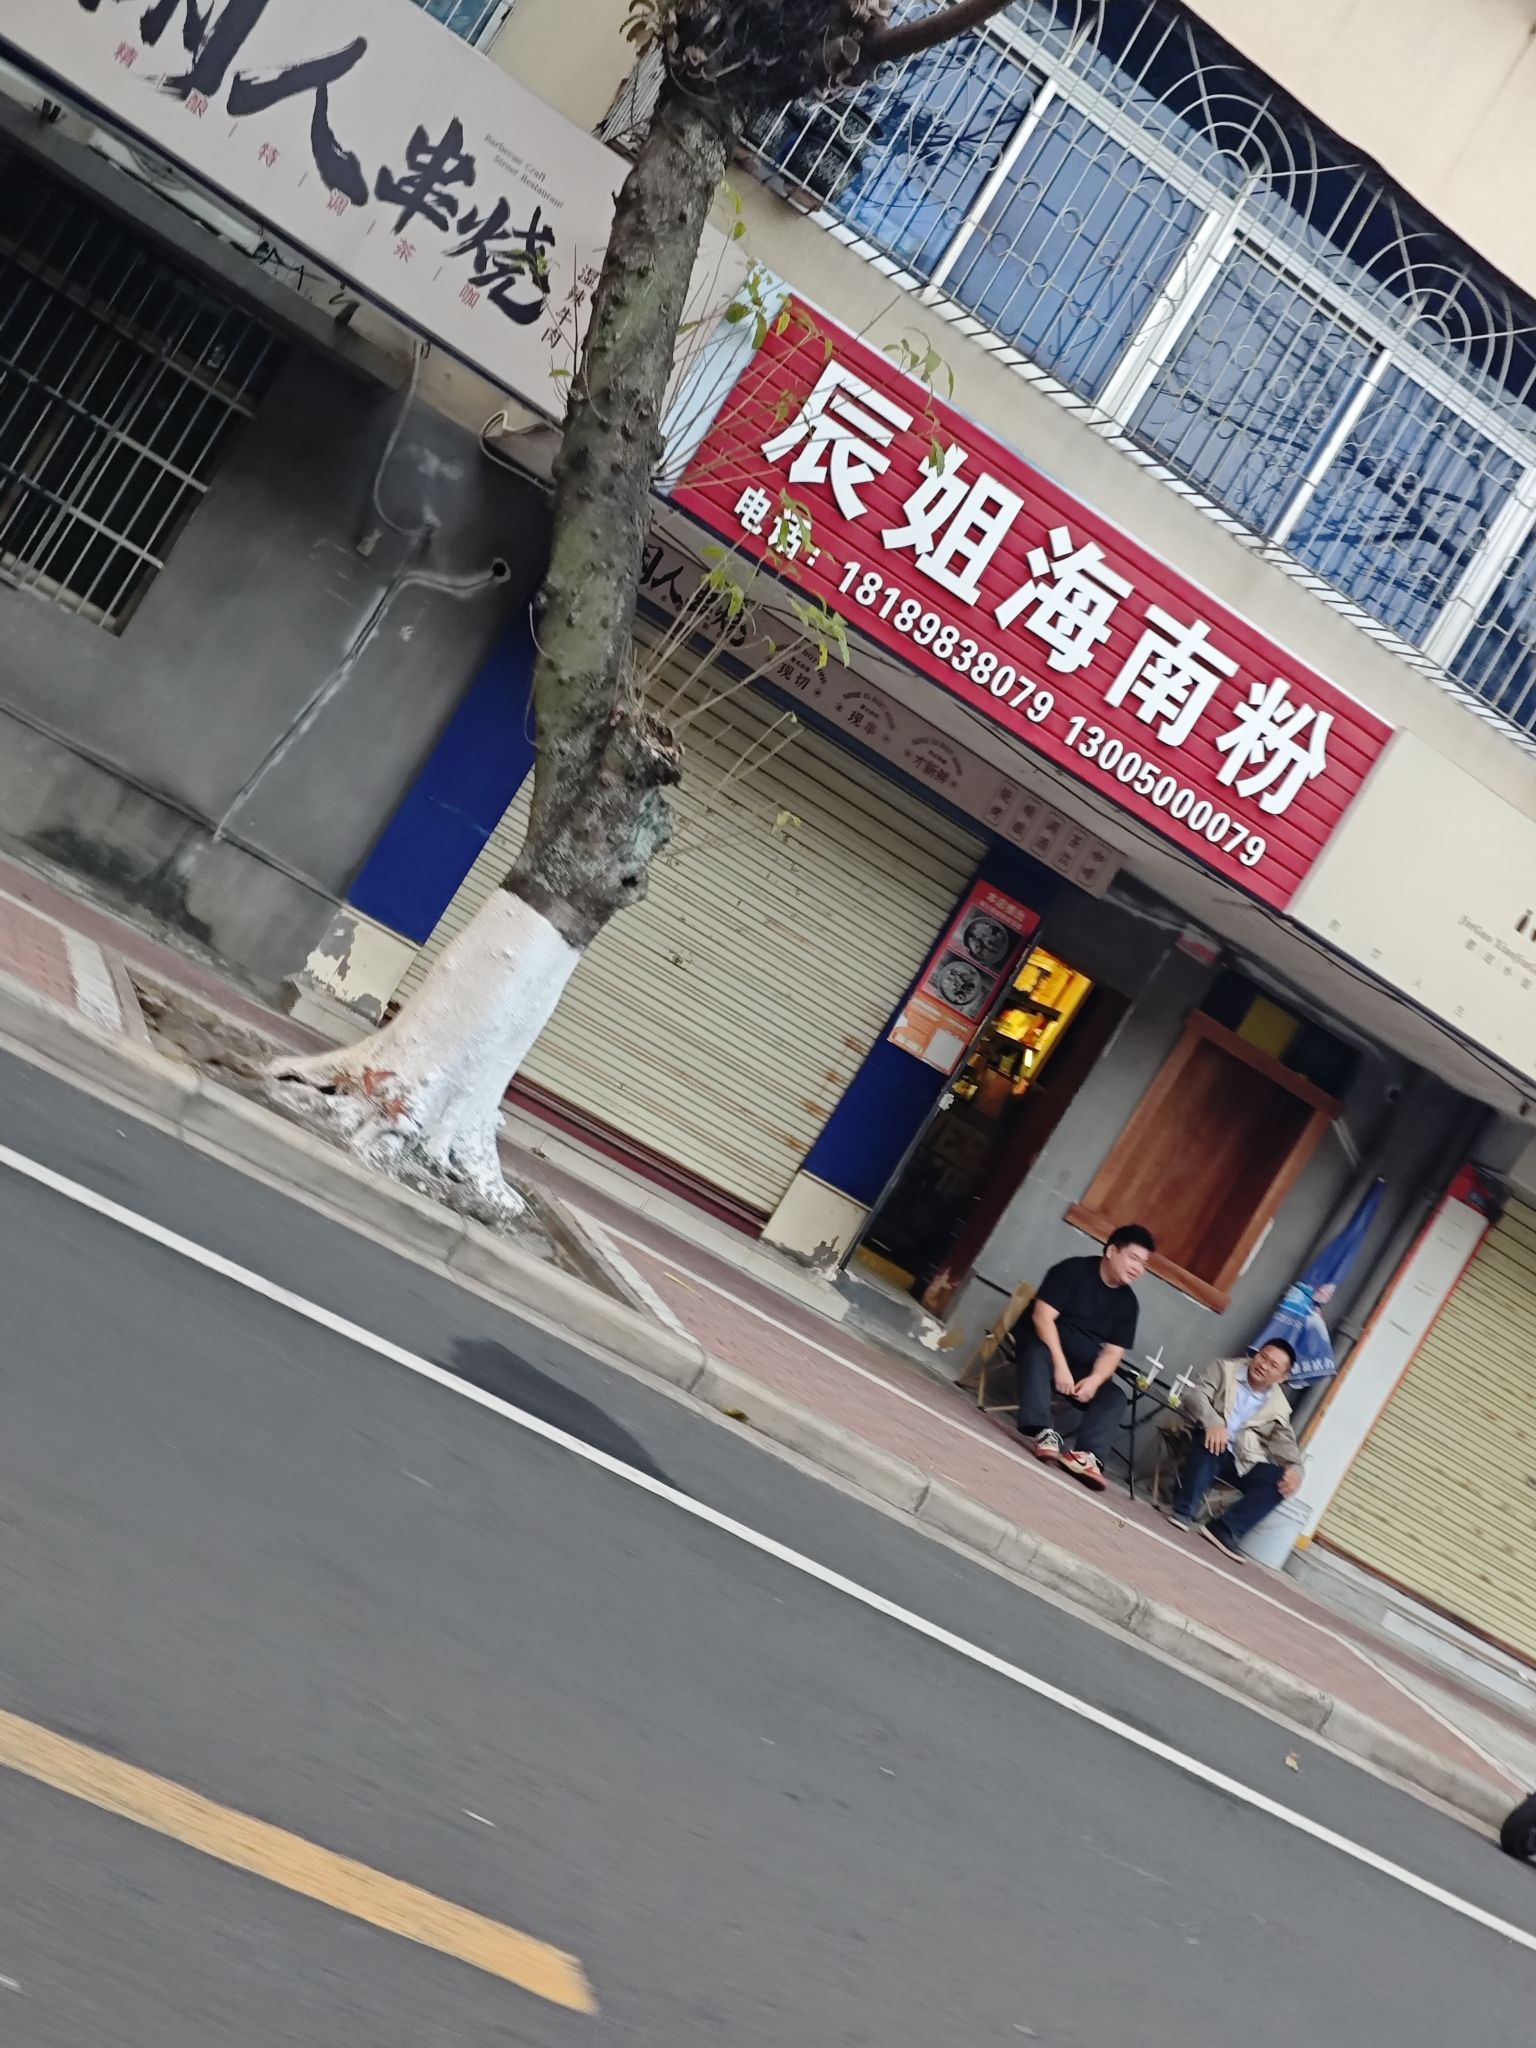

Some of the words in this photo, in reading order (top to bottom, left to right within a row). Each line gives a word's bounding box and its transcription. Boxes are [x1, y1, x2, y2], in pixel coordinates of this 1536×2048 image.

[520, 173, 564, 209] Restaurant
[760, 359, 1335, 815] 辰姐海南粉
[838, 561, 1055, 724] 18189838079
[1065, 715, 1267, 867] 13005000079
